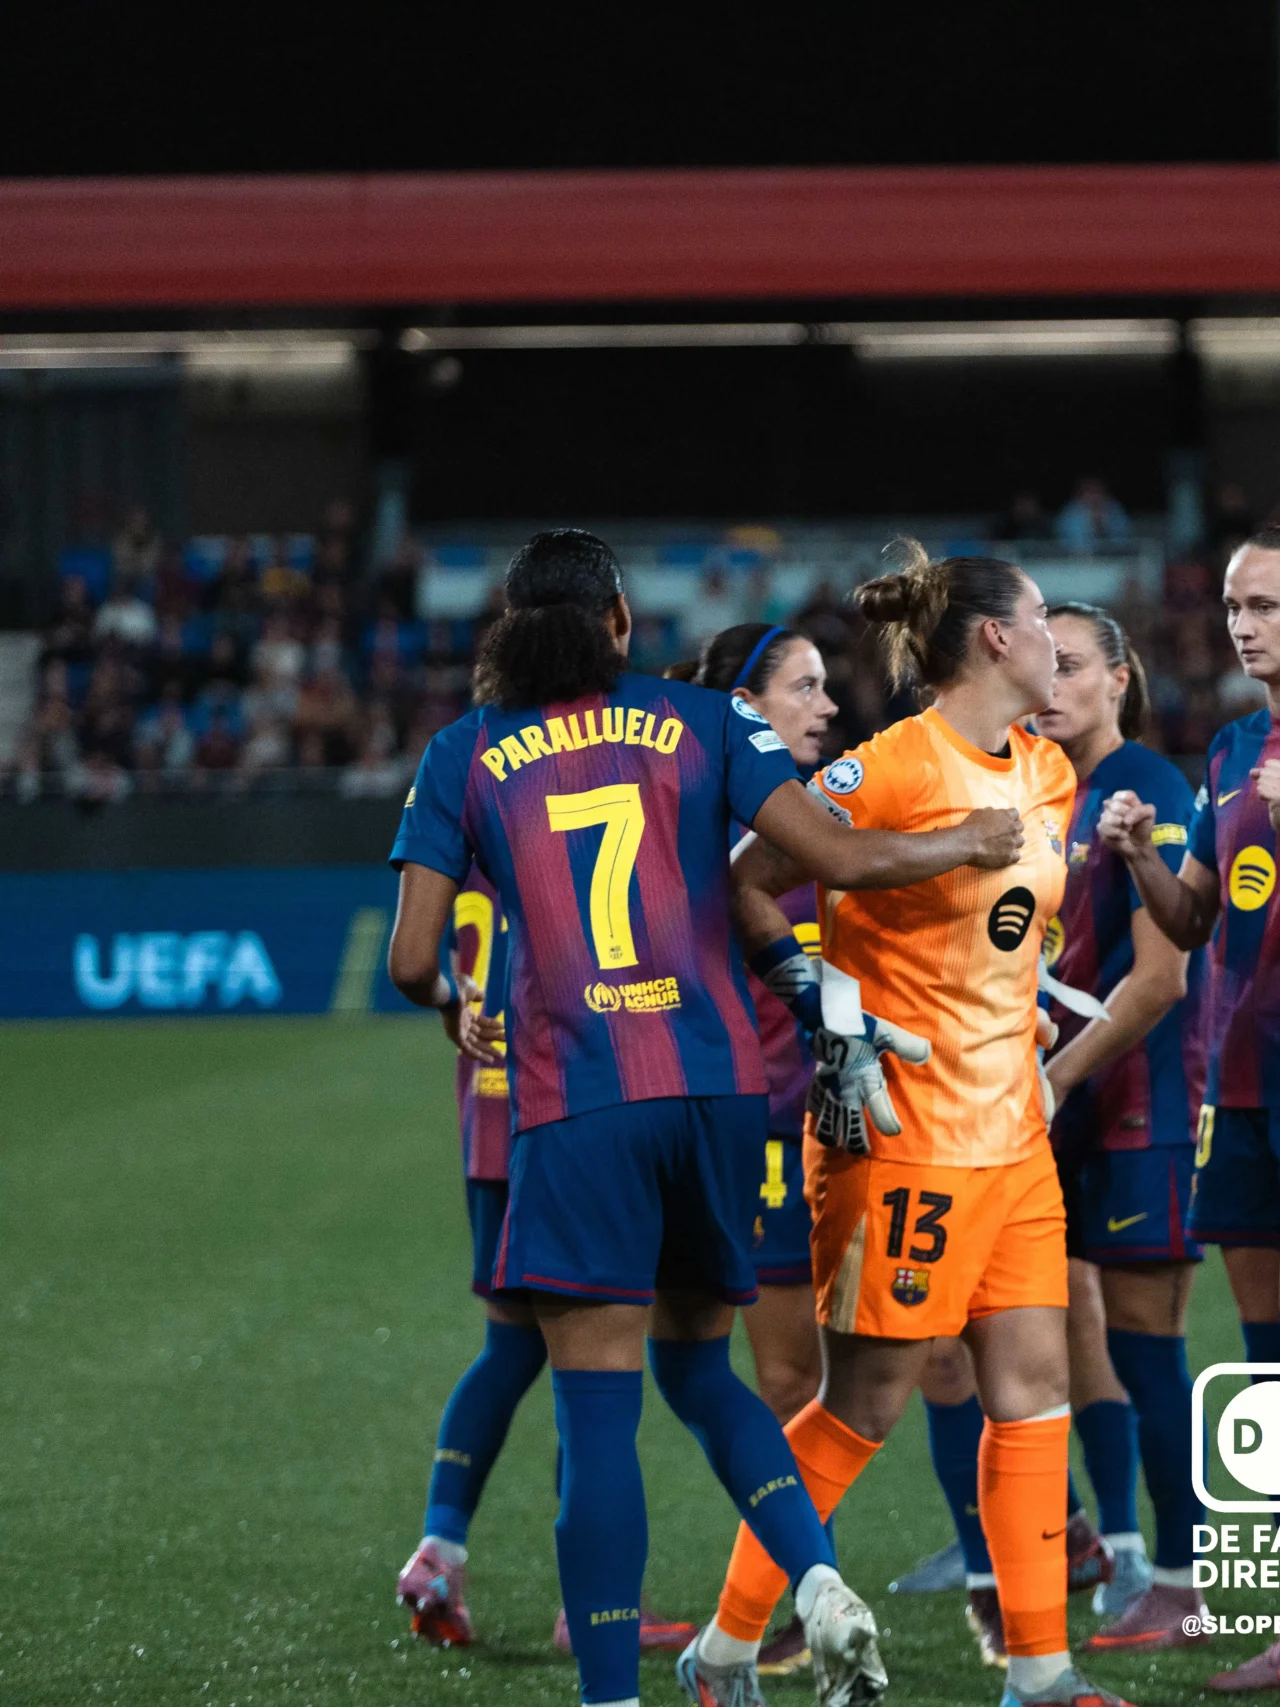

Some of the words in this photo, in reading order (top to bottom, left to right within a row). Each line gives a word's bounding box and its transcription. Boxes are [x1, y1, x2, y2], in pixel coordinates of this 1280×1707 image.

[480, 707, 684, 782] PARALLUELO
[545, 783, 645, 970] 7
[74, 930, 282, 1009] UEFA
[619, 977, 678, 997] UNHCR
[625, 990, 680, 1009] ACNUR
[883, 1187, 953, 1264] 13
